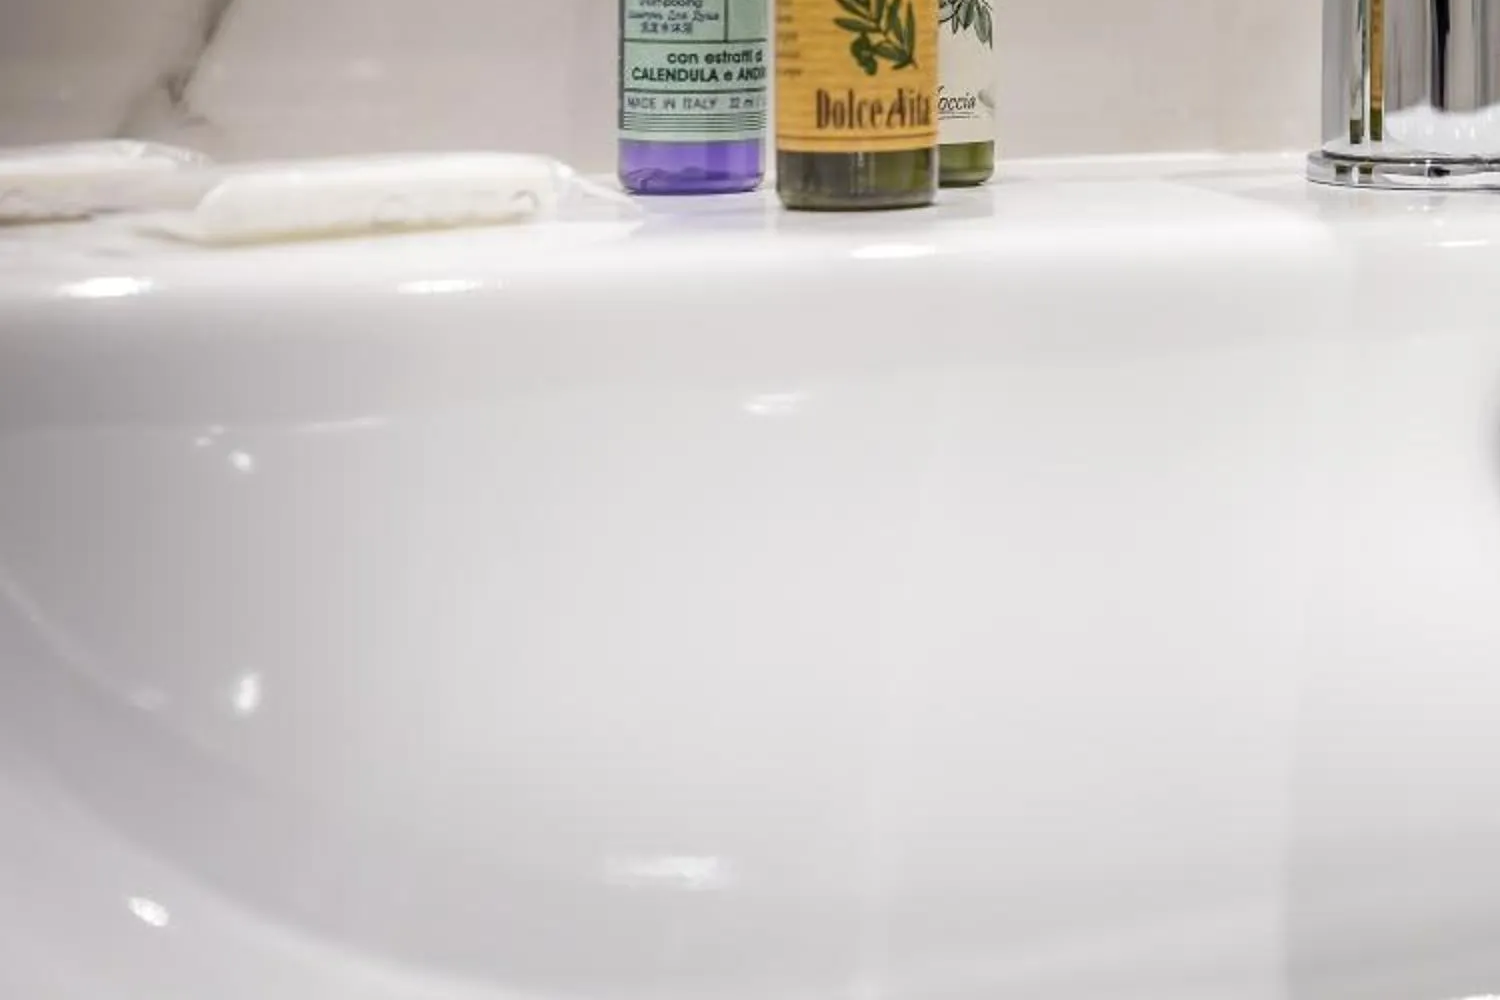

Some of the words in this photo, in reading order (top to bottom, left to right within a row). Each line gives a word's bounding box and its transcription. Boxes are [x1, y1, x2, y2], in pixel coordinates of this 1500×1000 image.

[667, 52, 699, 65] con
[631, 66, 720, 82] CALENDULA
[723, 69, 734, 82] e
